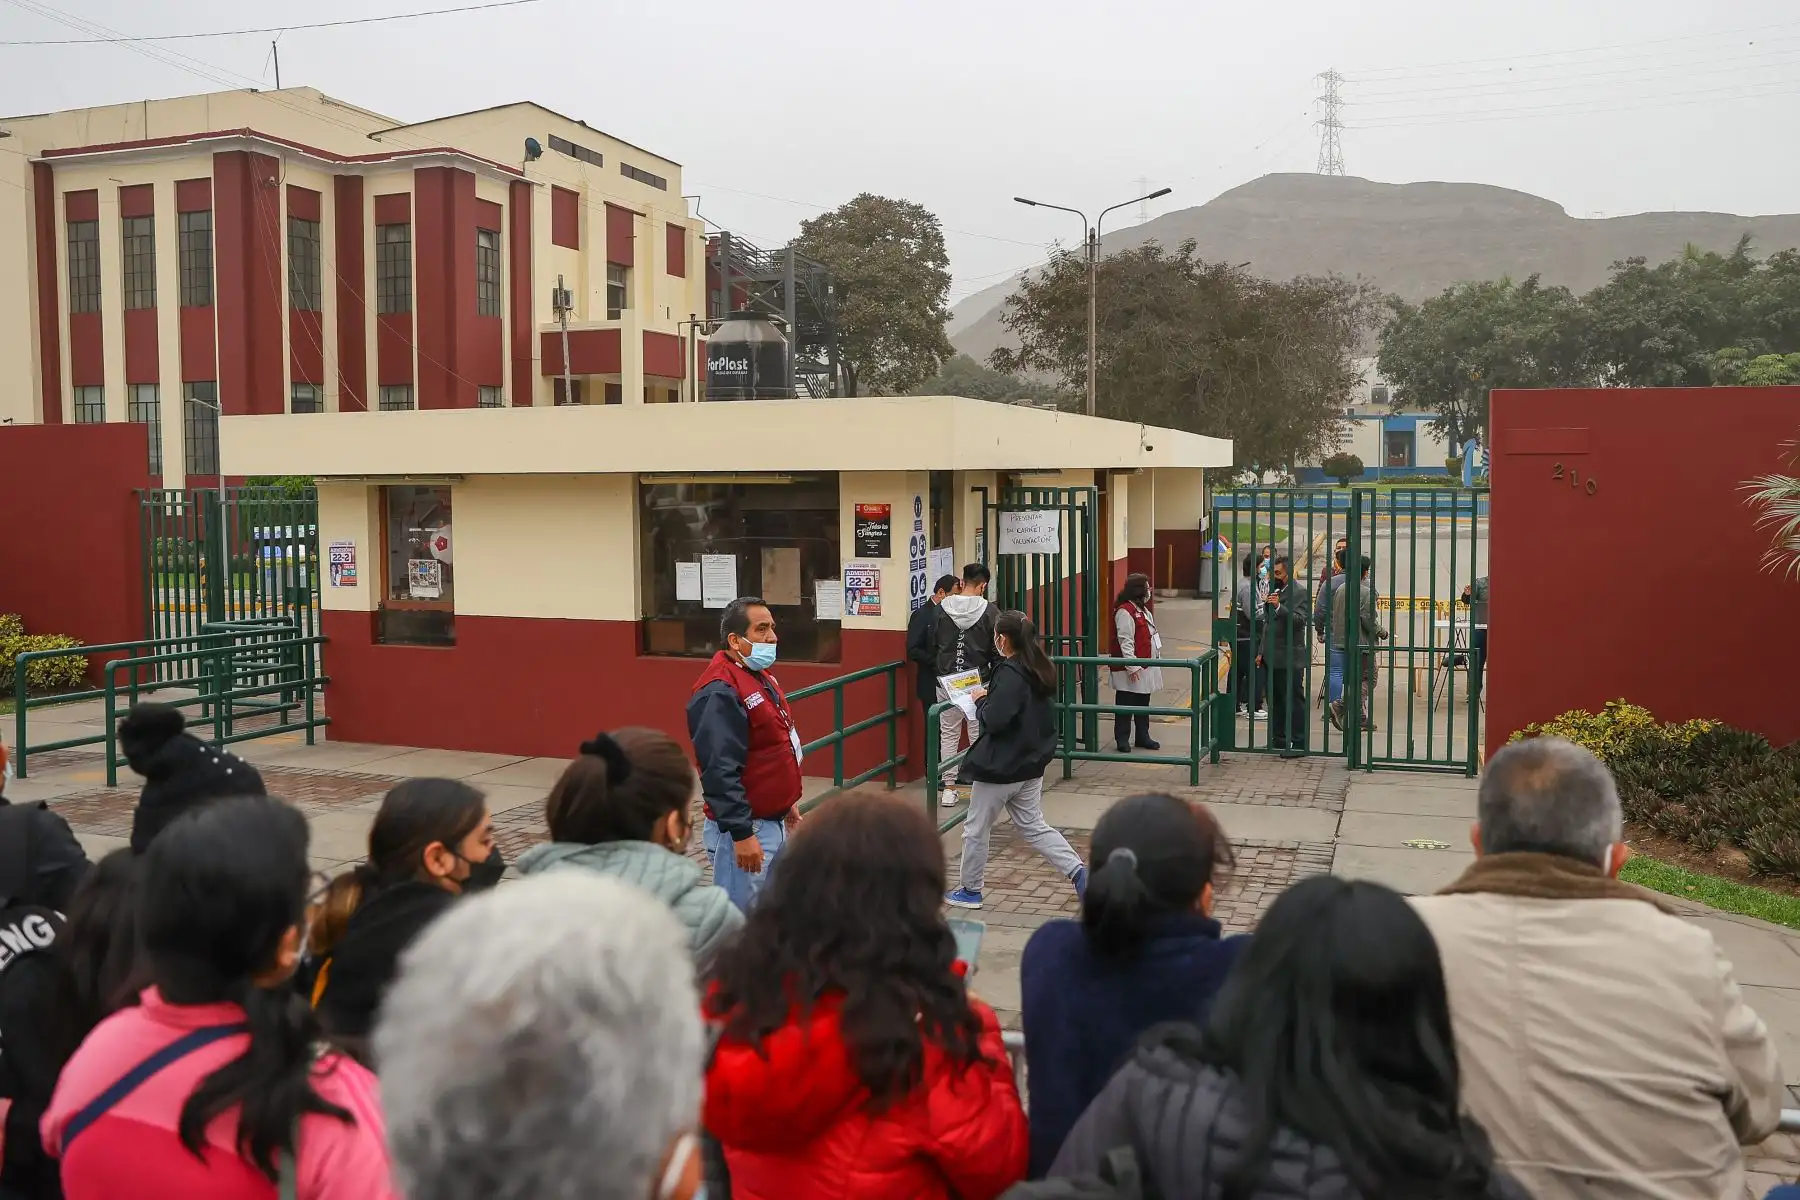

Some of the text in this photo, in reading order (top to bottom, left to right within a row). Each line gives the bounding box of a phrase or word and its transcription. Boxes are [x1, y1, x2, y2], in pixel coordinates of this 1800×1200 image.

[1552, 462, 1597, 495] 210
[1010, 513, 1043, 522] PRESENTAR
[332, 553, 350, 562] 22-2
[848, 577, 872, 587] 22-2
